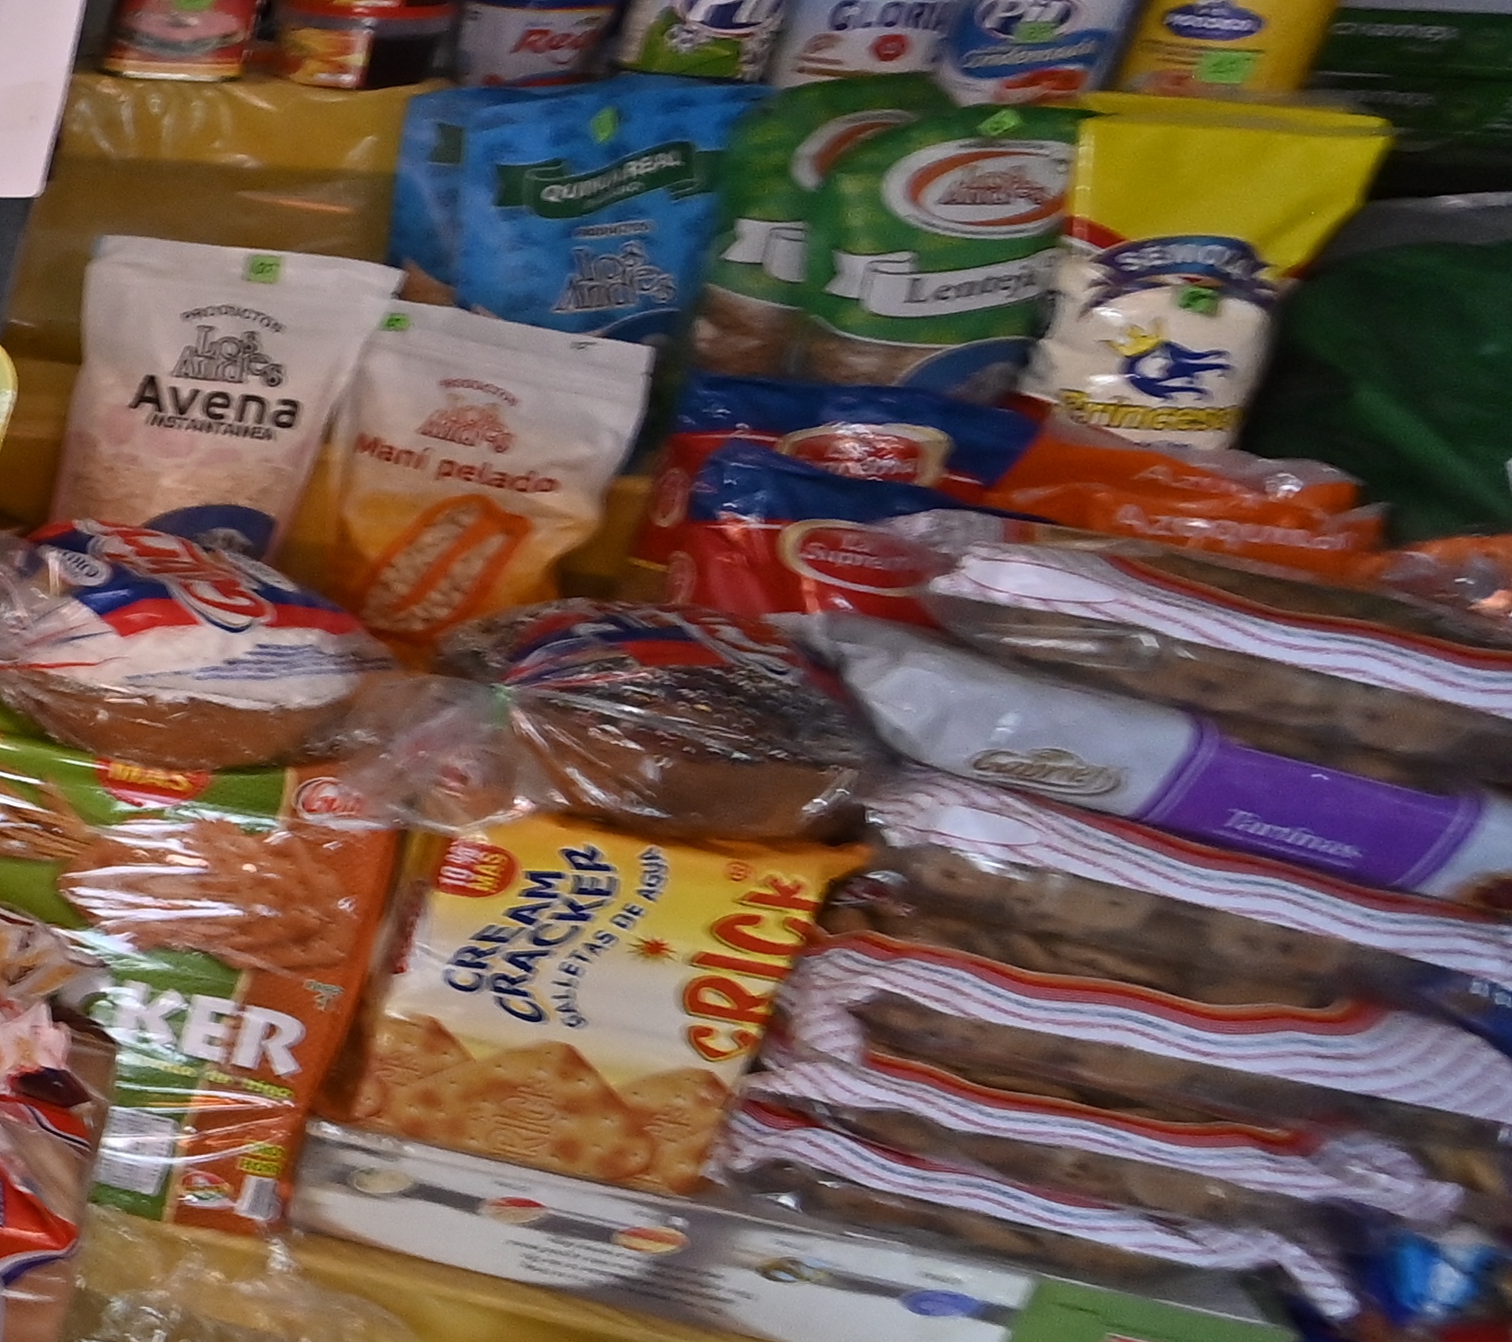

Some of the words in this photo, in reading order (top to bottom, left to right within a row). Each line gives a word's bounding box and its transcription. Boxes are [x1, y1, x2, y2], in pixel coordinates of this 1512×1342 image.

[904, 265, 1038, 303] Lentej
[170, 347, 284, 387] Andes
[195, 324, 259, 358] Los
[129, 374, 303, 430] Avena
[435, 455, 561, 495] pelado
[443, 869, 567, 994] CREAM
[491, 841, 622, 1025] CRACKER
[551, 928, 620, 1029] GALLETAS
[609, 902, 646, 932] DE
[637, 844, 672, 903] AGUA
[681, 870, 820, 1062] CRICK
